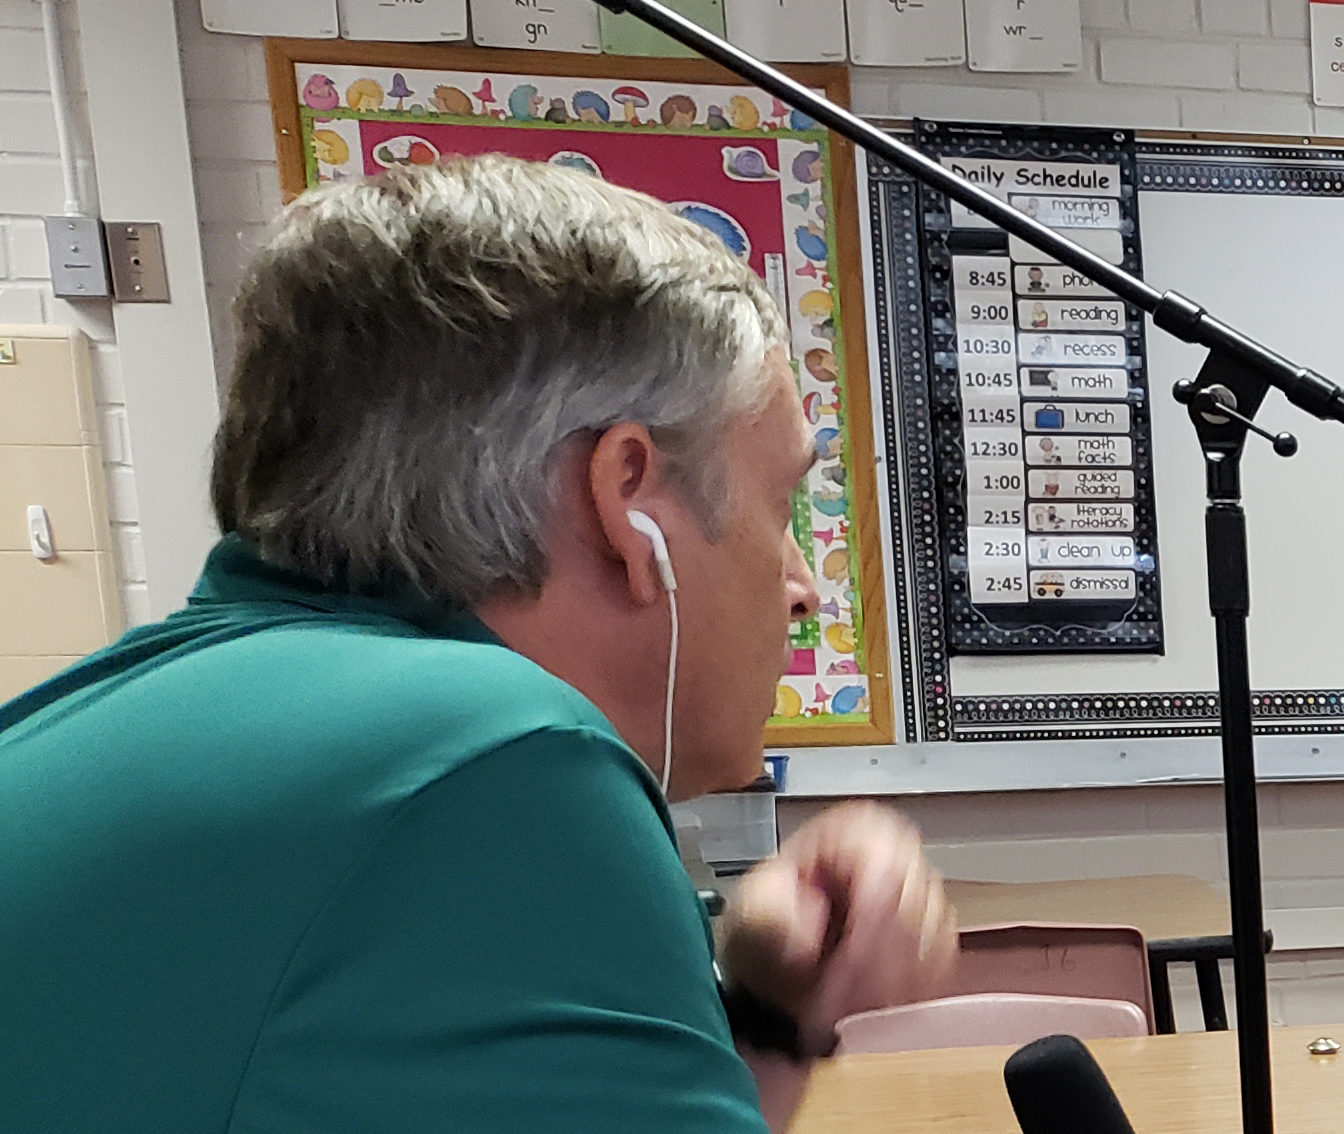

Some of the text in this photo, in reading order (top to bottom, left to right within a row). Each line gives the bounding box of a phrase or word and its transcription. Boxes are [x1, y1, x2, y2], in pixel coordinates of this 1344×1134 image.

[525, 22, 548, 43] gn
[1334, 37, 1344, 48] s
[1014, 167, 1110, 190] Schedule
[1052, 198, 1110, 217] morning
[1062, 213, 1100, 226] work
[968, 270, 1007, 287] 8:45
[970, 304, 1119, 325] 9:00 reading
[963, 338, 1117, 357] 10:30 recess
[964, 371, 1113, 390] 10:45 math
[968, 408, 1115, 425] 11:45 lunch
[970, 437, 1116, 457] 12:30 math
[1077, 451, 1117, 464] facts
[983, 470, 1118, 491] 1:00 guided
[1074, 483, 1121, 497] reading
[983, 503, 1123, 525] 2:15 literacy
[1070, 516, 1128, 530] rotations
[983, 541, 1132, 561] 2:30 clean up
[985, 575, 1130, 592] 2:45 dismissal
